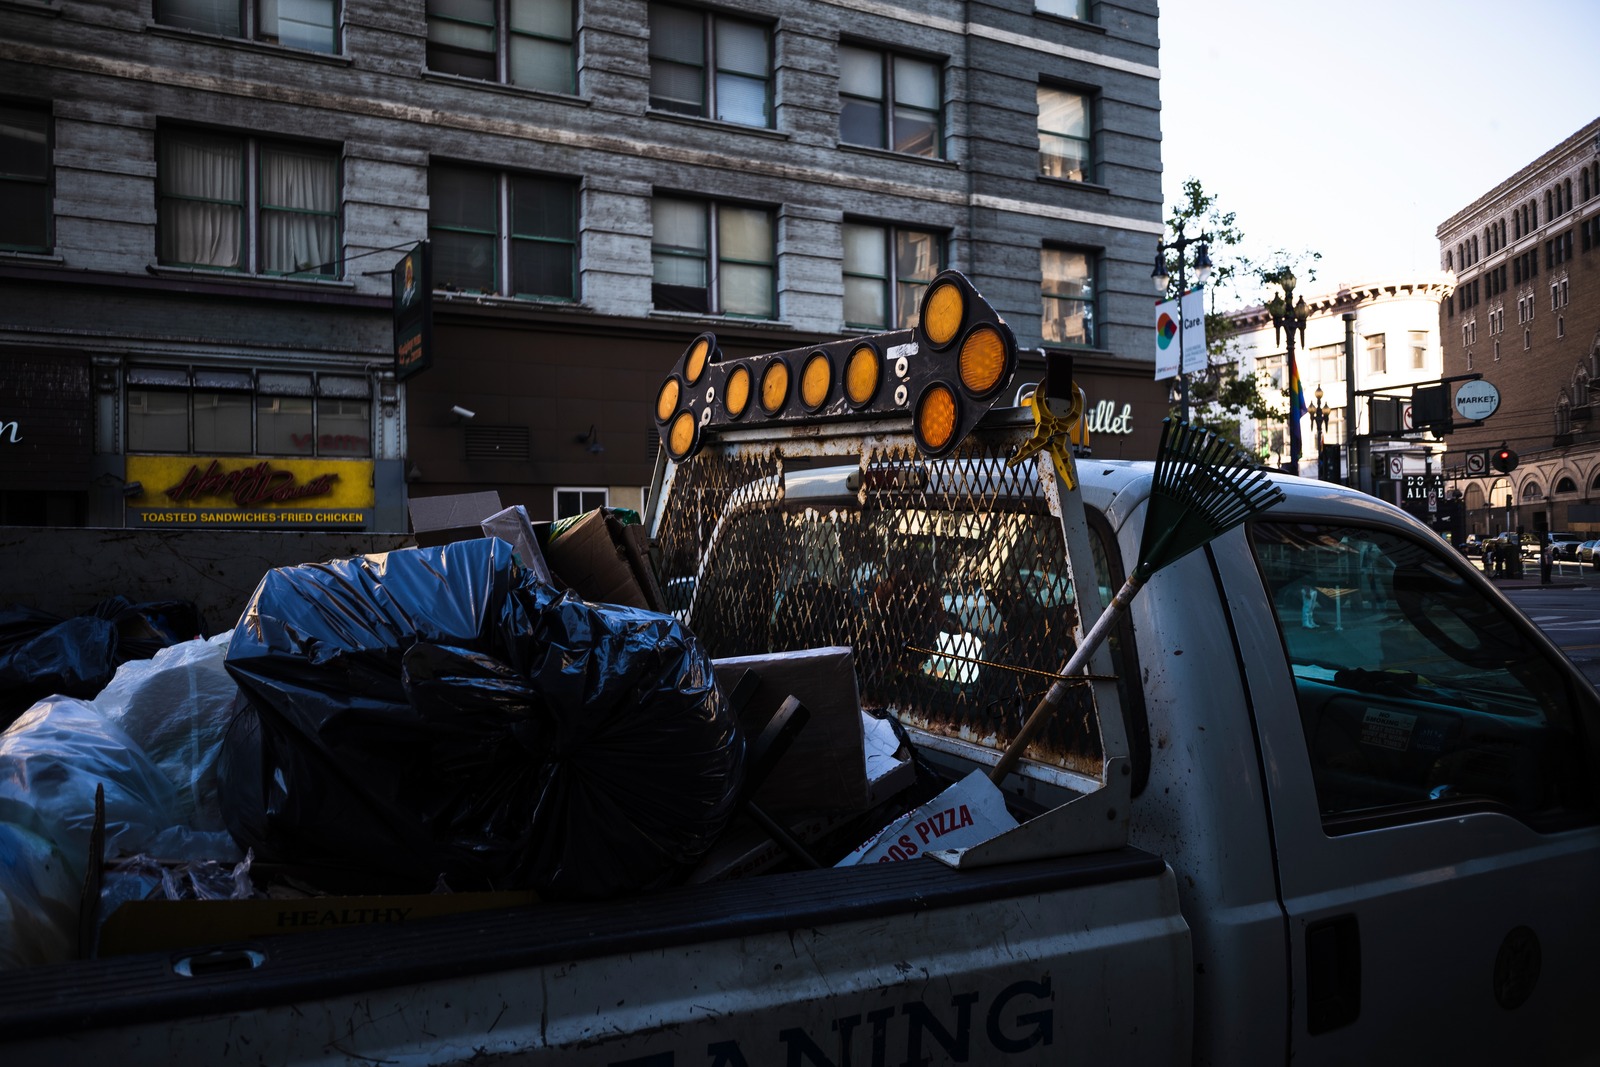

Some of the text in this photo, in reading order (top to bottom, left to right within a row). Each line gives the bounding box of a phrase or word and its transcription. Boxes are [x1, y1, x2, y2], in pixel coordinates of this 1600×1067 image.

[1458, 395, 1495, 405] MARKET
[141, 512, 197, 522] TOASTED
[315, 513, 363, 522] CHICKEN
[1366, 716, 1399, 726] SMOKING
[915, 804, 974, 845] PIZZA
[276, 907, 413, 927] HEALTHY
